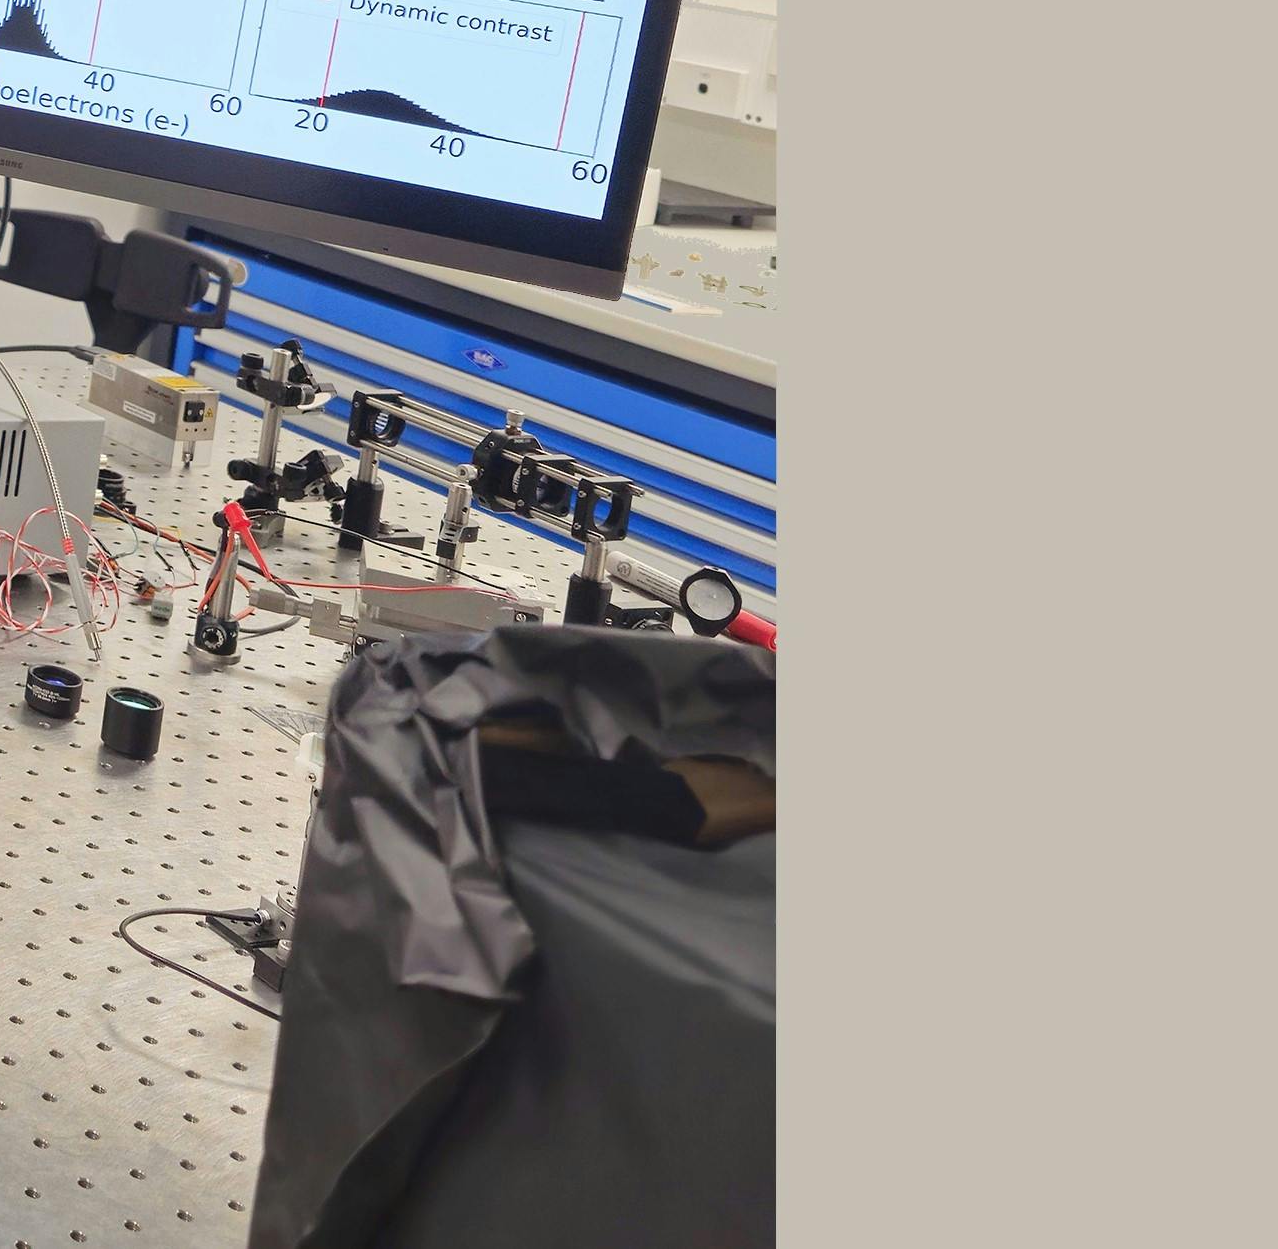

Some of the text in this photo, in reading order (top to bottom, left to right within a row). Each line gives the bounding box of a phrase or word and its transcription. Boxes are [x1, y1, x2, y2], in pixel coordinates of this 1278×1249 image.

[456, 13, 554, 43] contrast
[83, 70, 116, 94] 40
[209, 93, 243, 117] 60
[143, 106, 191, 138] (e-)
[294, 109, 329, 133] 20
[429, 134, 466, 160] 40
[571, 159, 609, 186] 60
